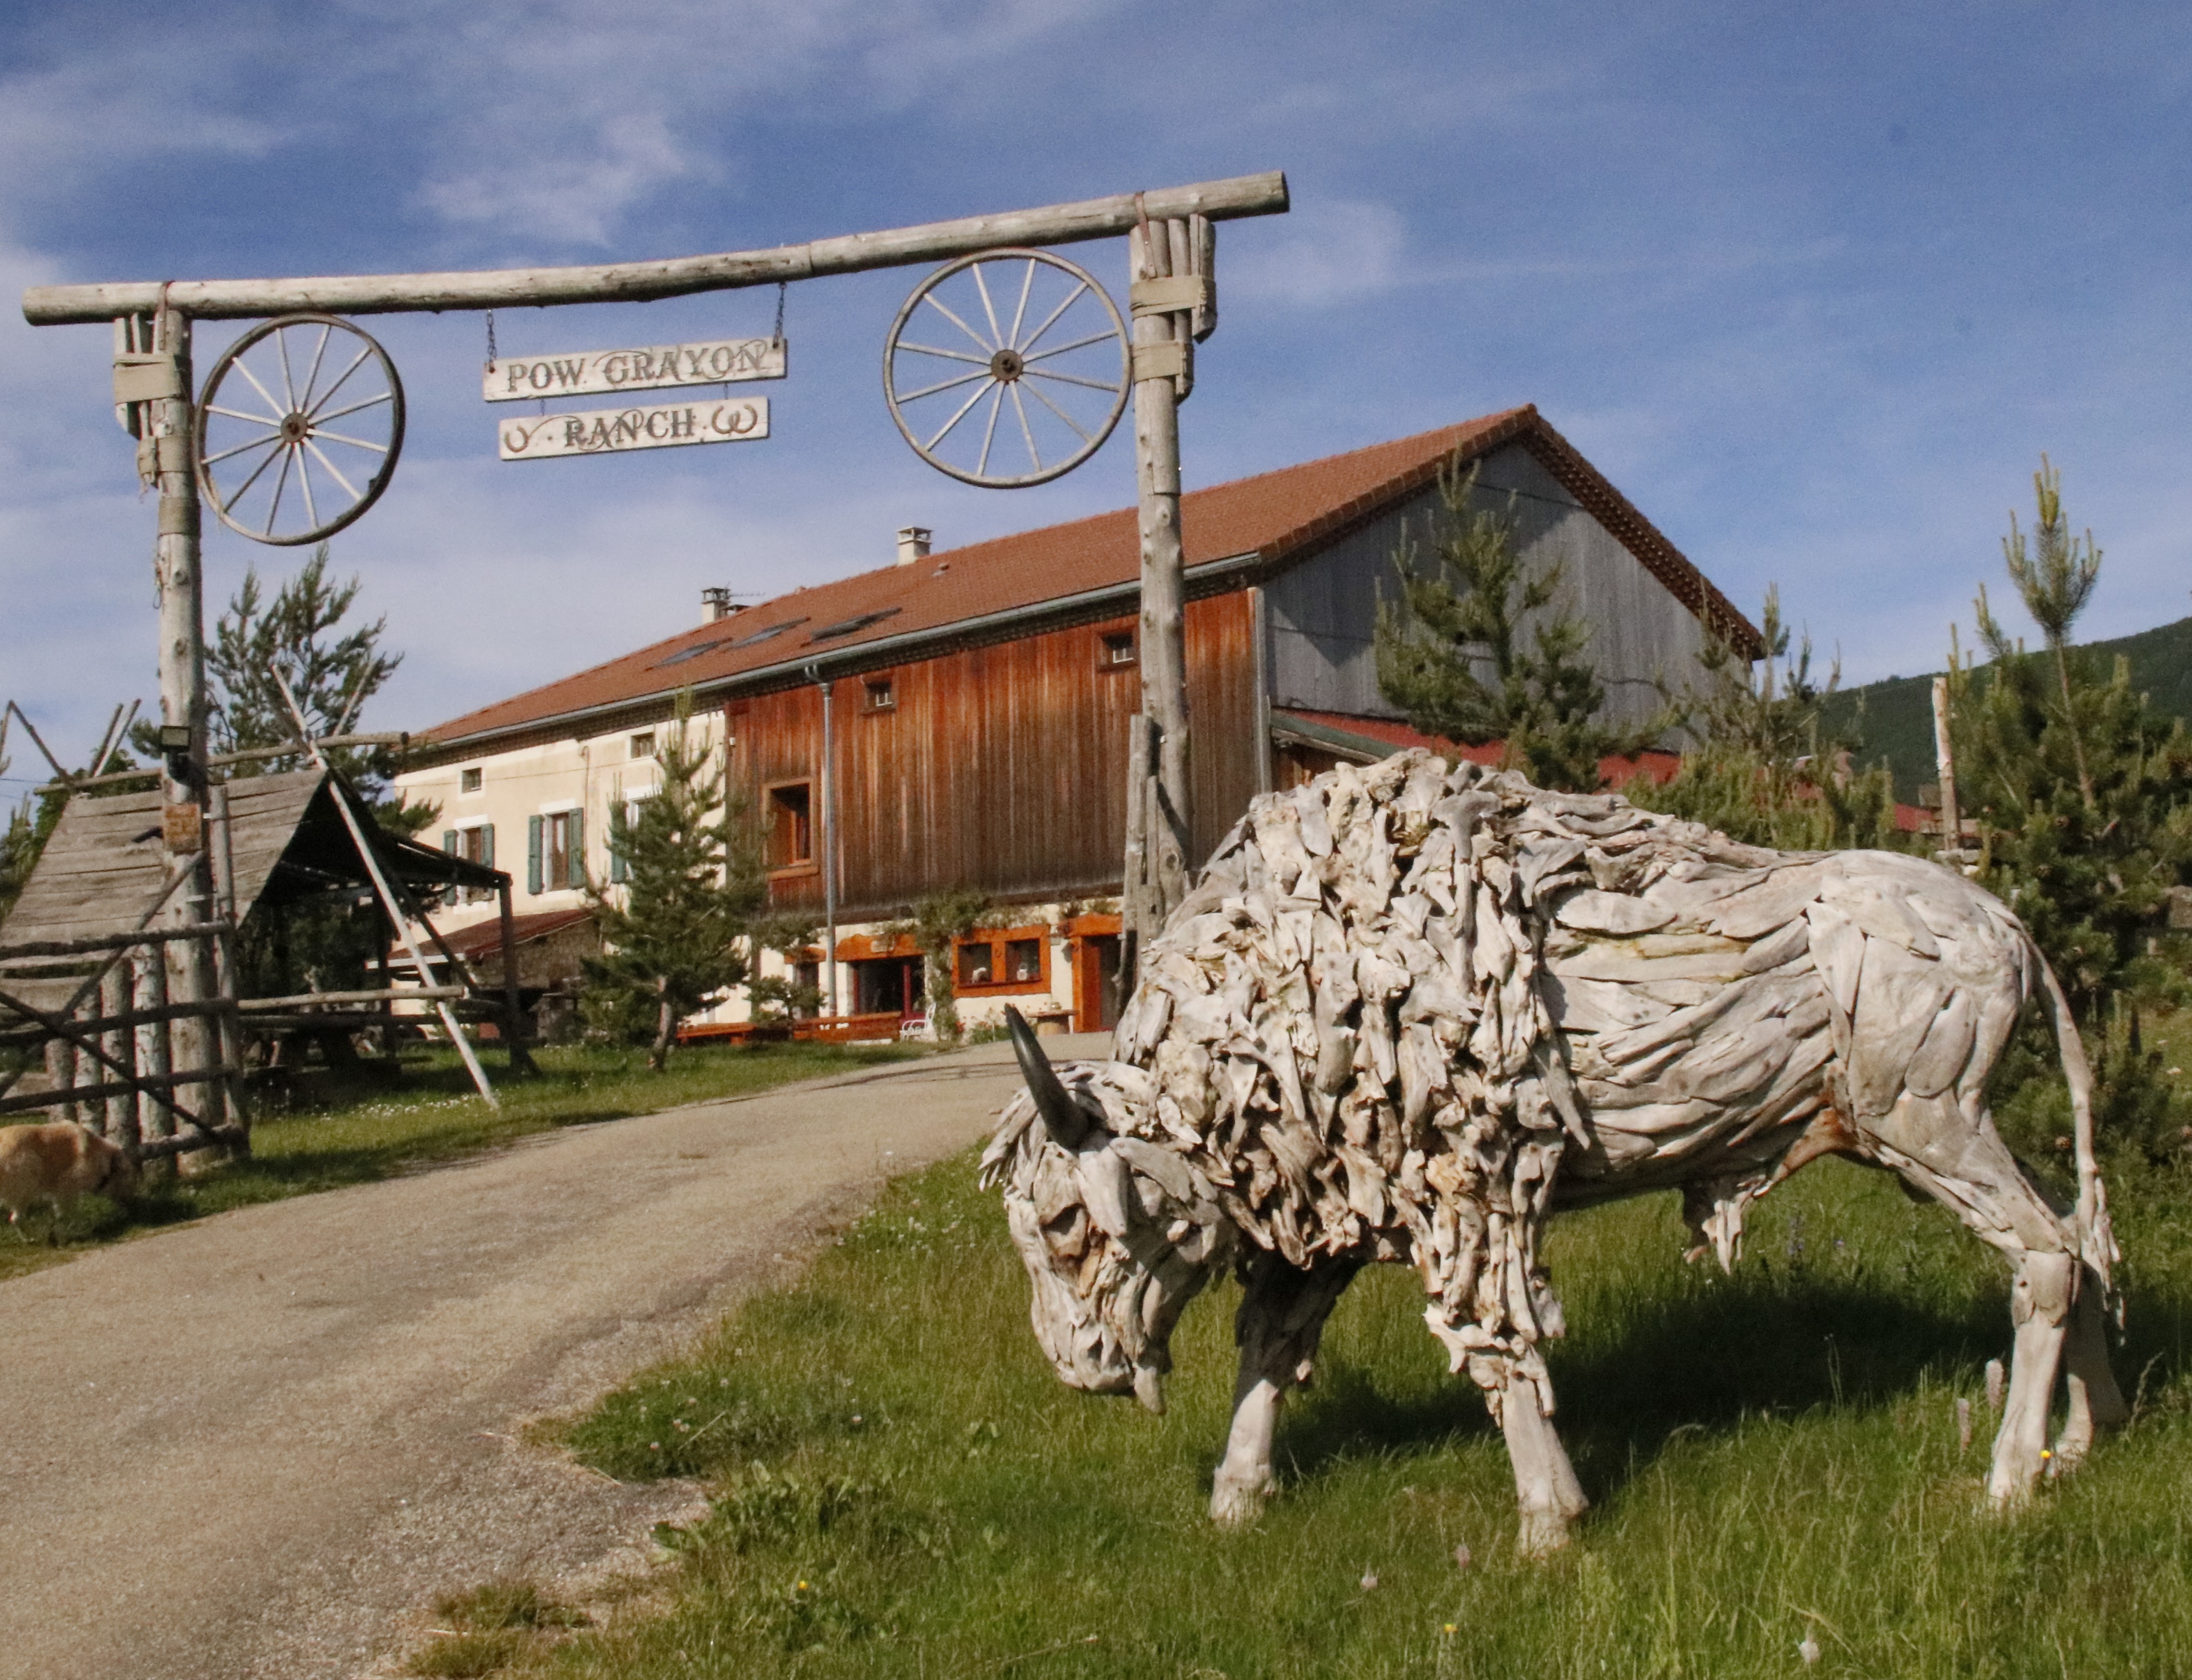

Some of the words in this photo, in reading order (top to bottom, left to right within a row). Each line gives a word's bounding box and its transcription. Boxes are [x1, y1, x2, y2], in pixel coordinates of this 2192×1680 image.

[508, 358, 586, 393] POW
[599, 340, 768, 385] GRAYON
[564, 408, 695, 450] RANCH
